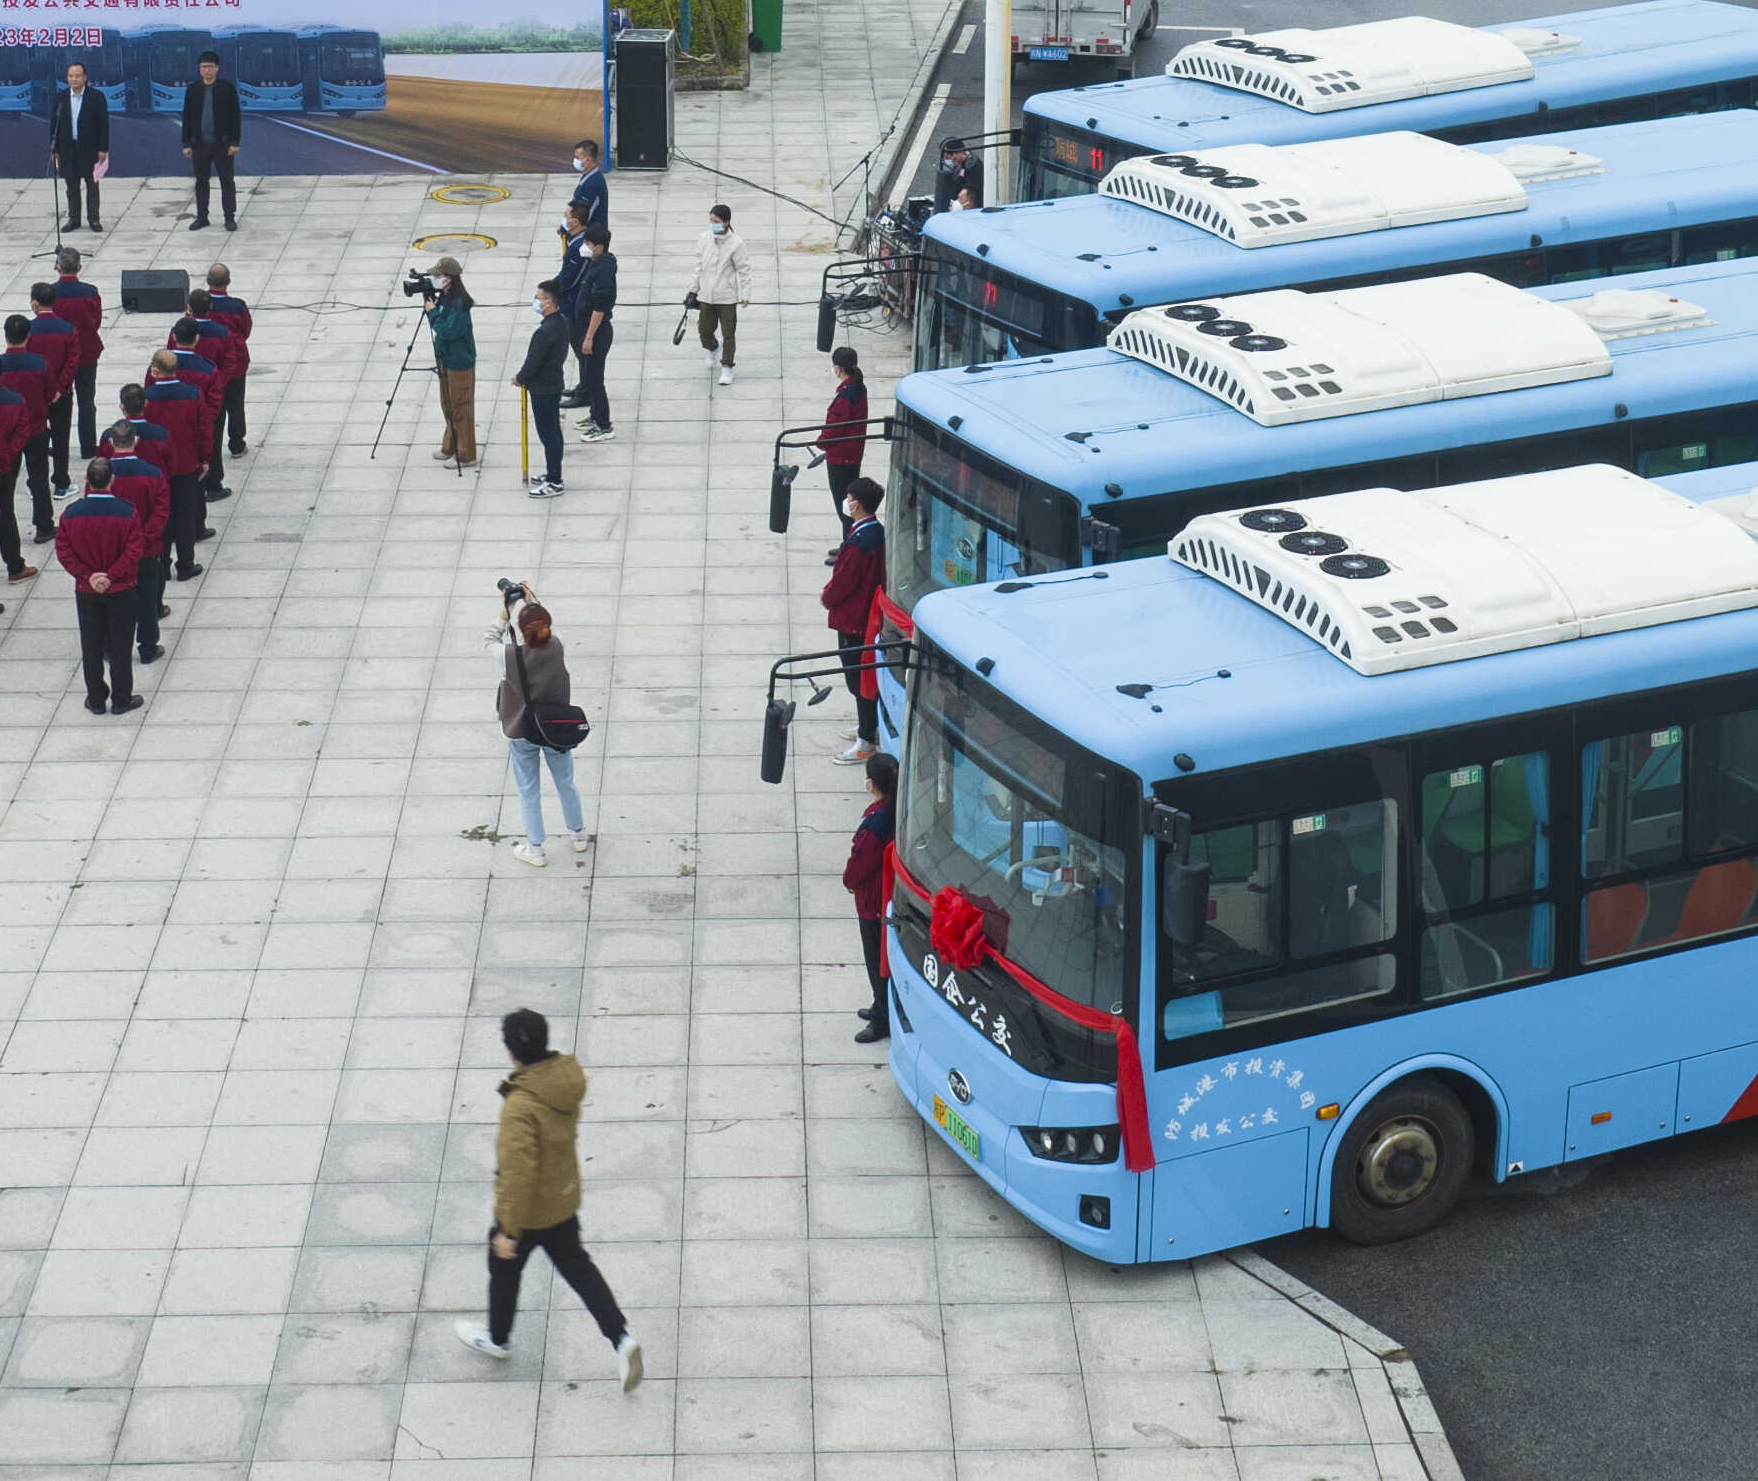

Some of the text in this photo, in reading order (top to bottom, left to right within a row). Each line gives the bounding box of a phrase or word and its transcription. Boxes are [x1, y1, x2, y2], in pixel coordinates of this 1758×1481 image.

[1090, 147, 1104, 171] 11
[985, 281, 998, 307] 11
[922, 953, 1012, 1057] 国企公交
[949, 1074, 969, 1099] BYD
[1190, 1106, 1280, 1142] 投发公交
